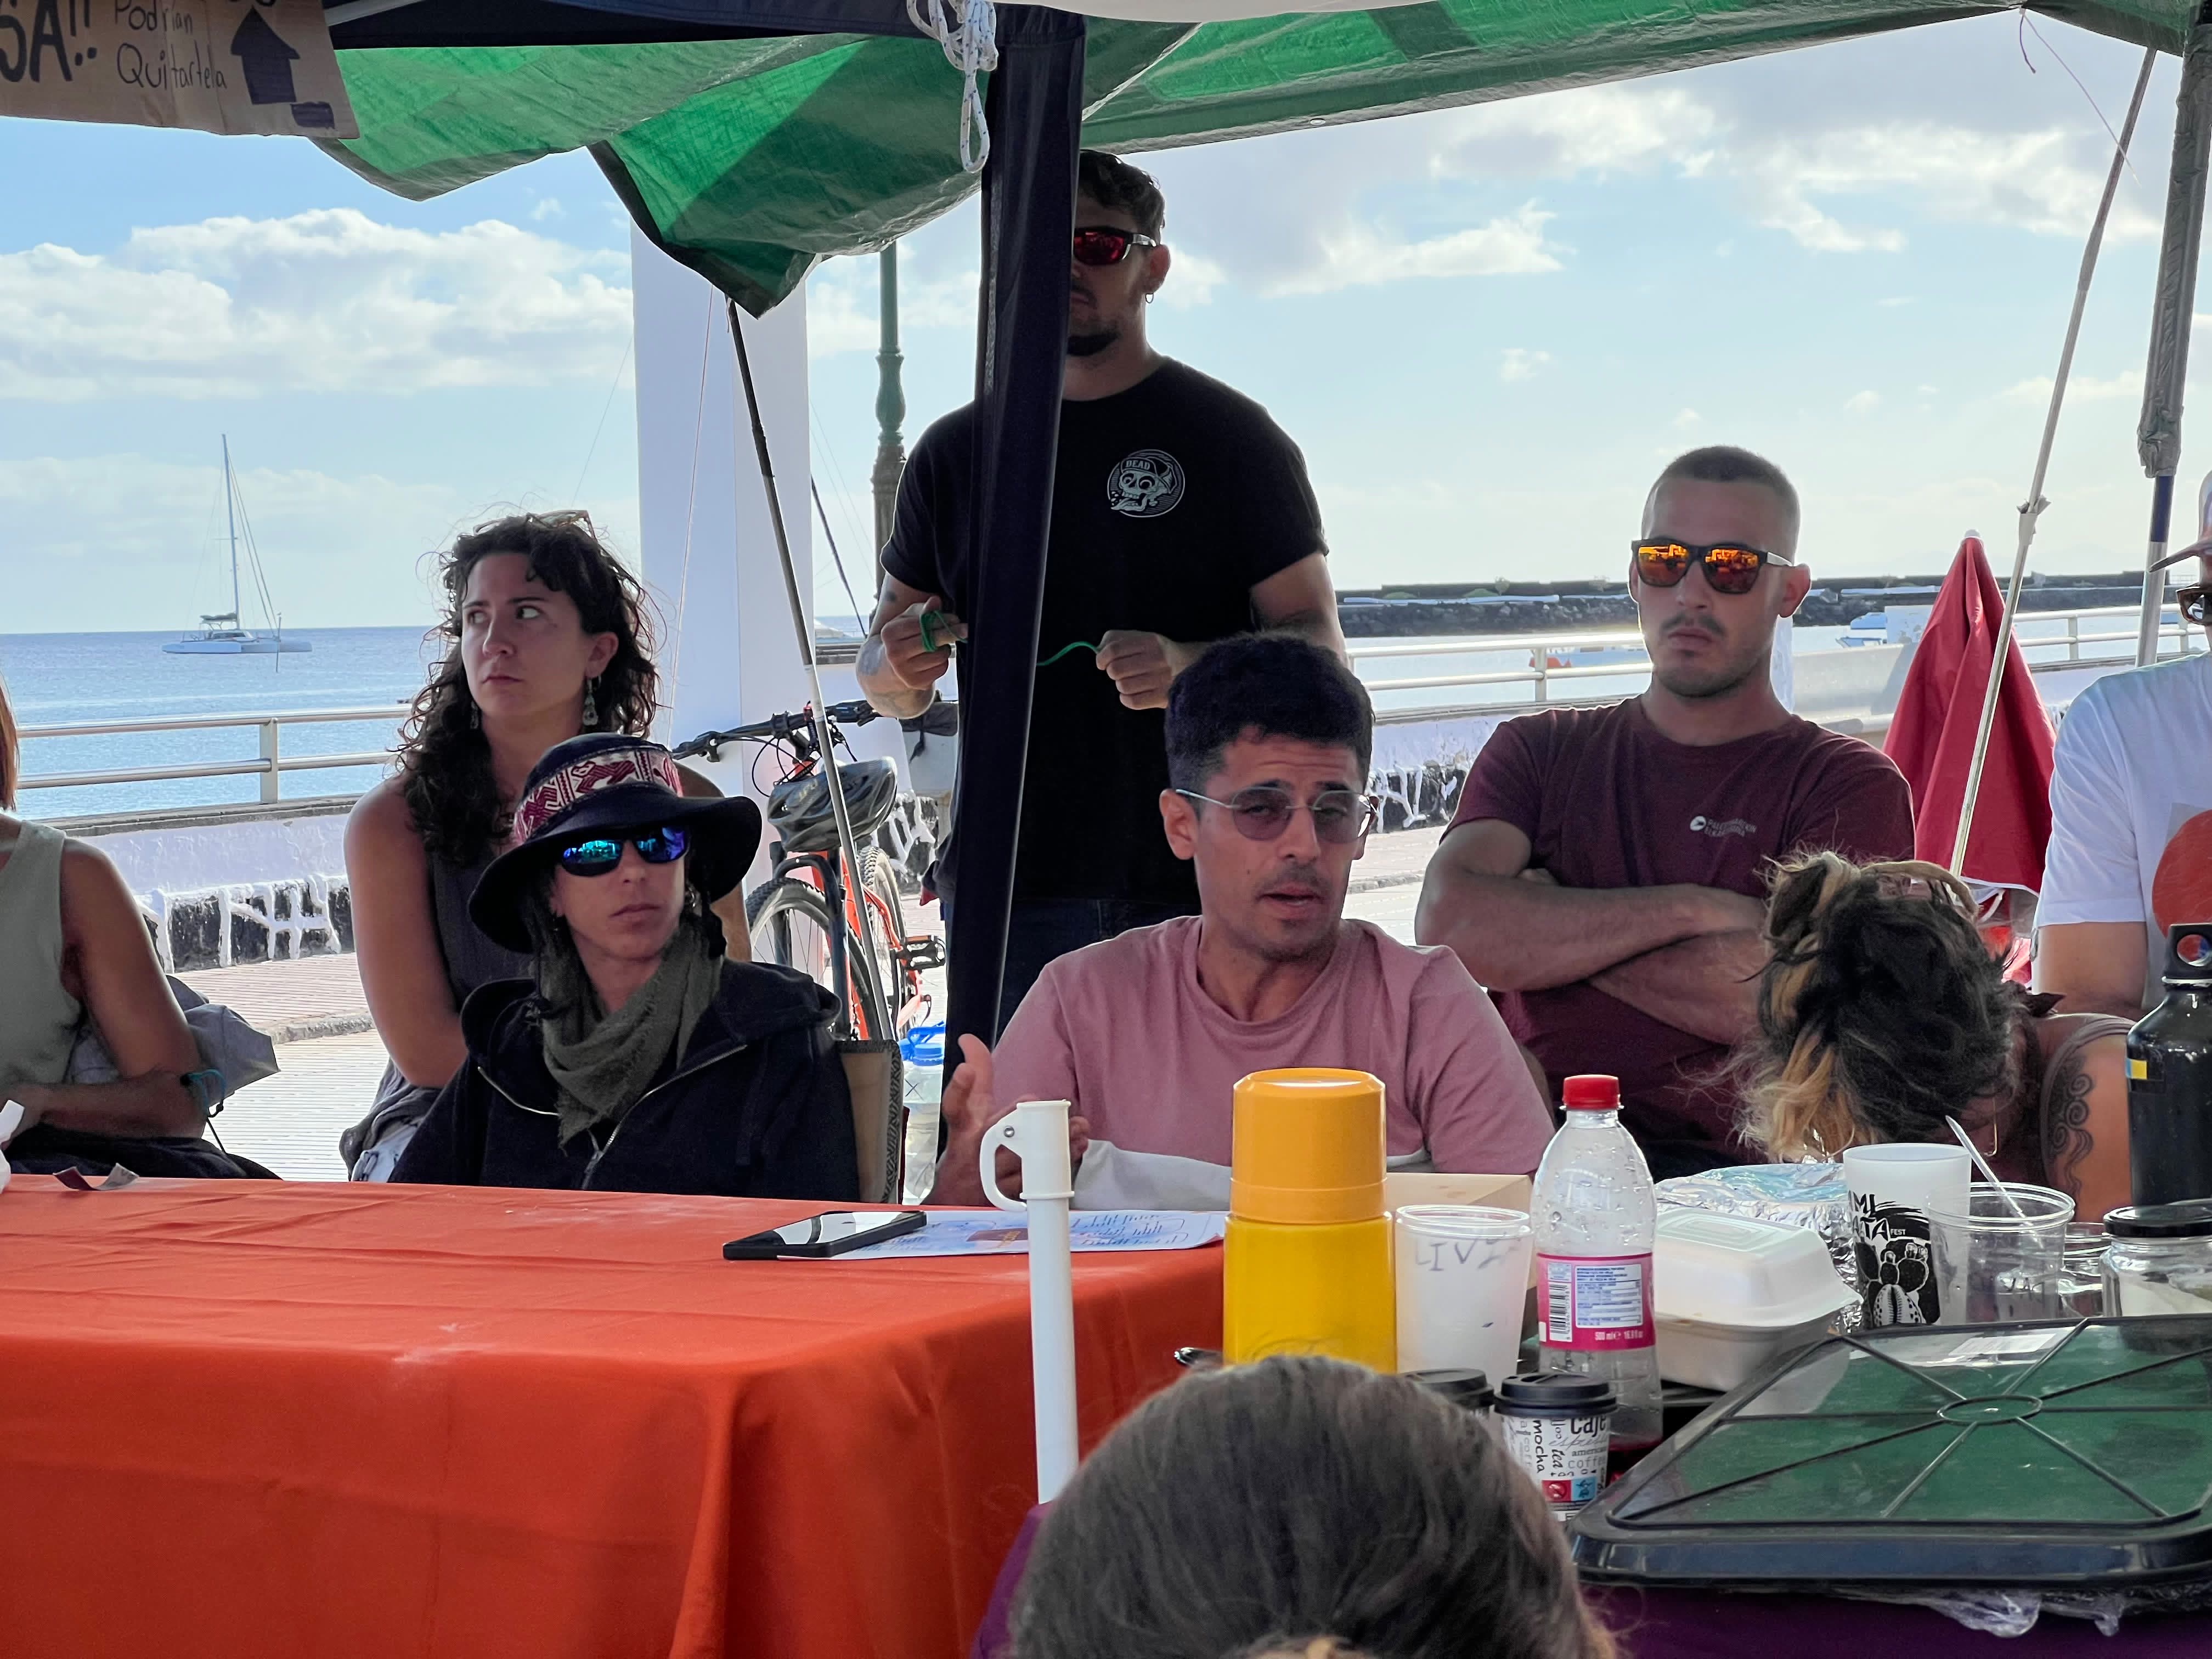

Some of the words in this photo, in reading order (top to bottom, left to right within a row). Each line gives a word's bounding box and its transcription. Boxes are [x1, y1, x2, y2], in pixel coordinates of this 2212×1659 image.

[1126, 460, 1150, 470] DEAD
[1532, 1419, 1548, 1474] mocha
[1551, 1449, 1566, 1468] tea
